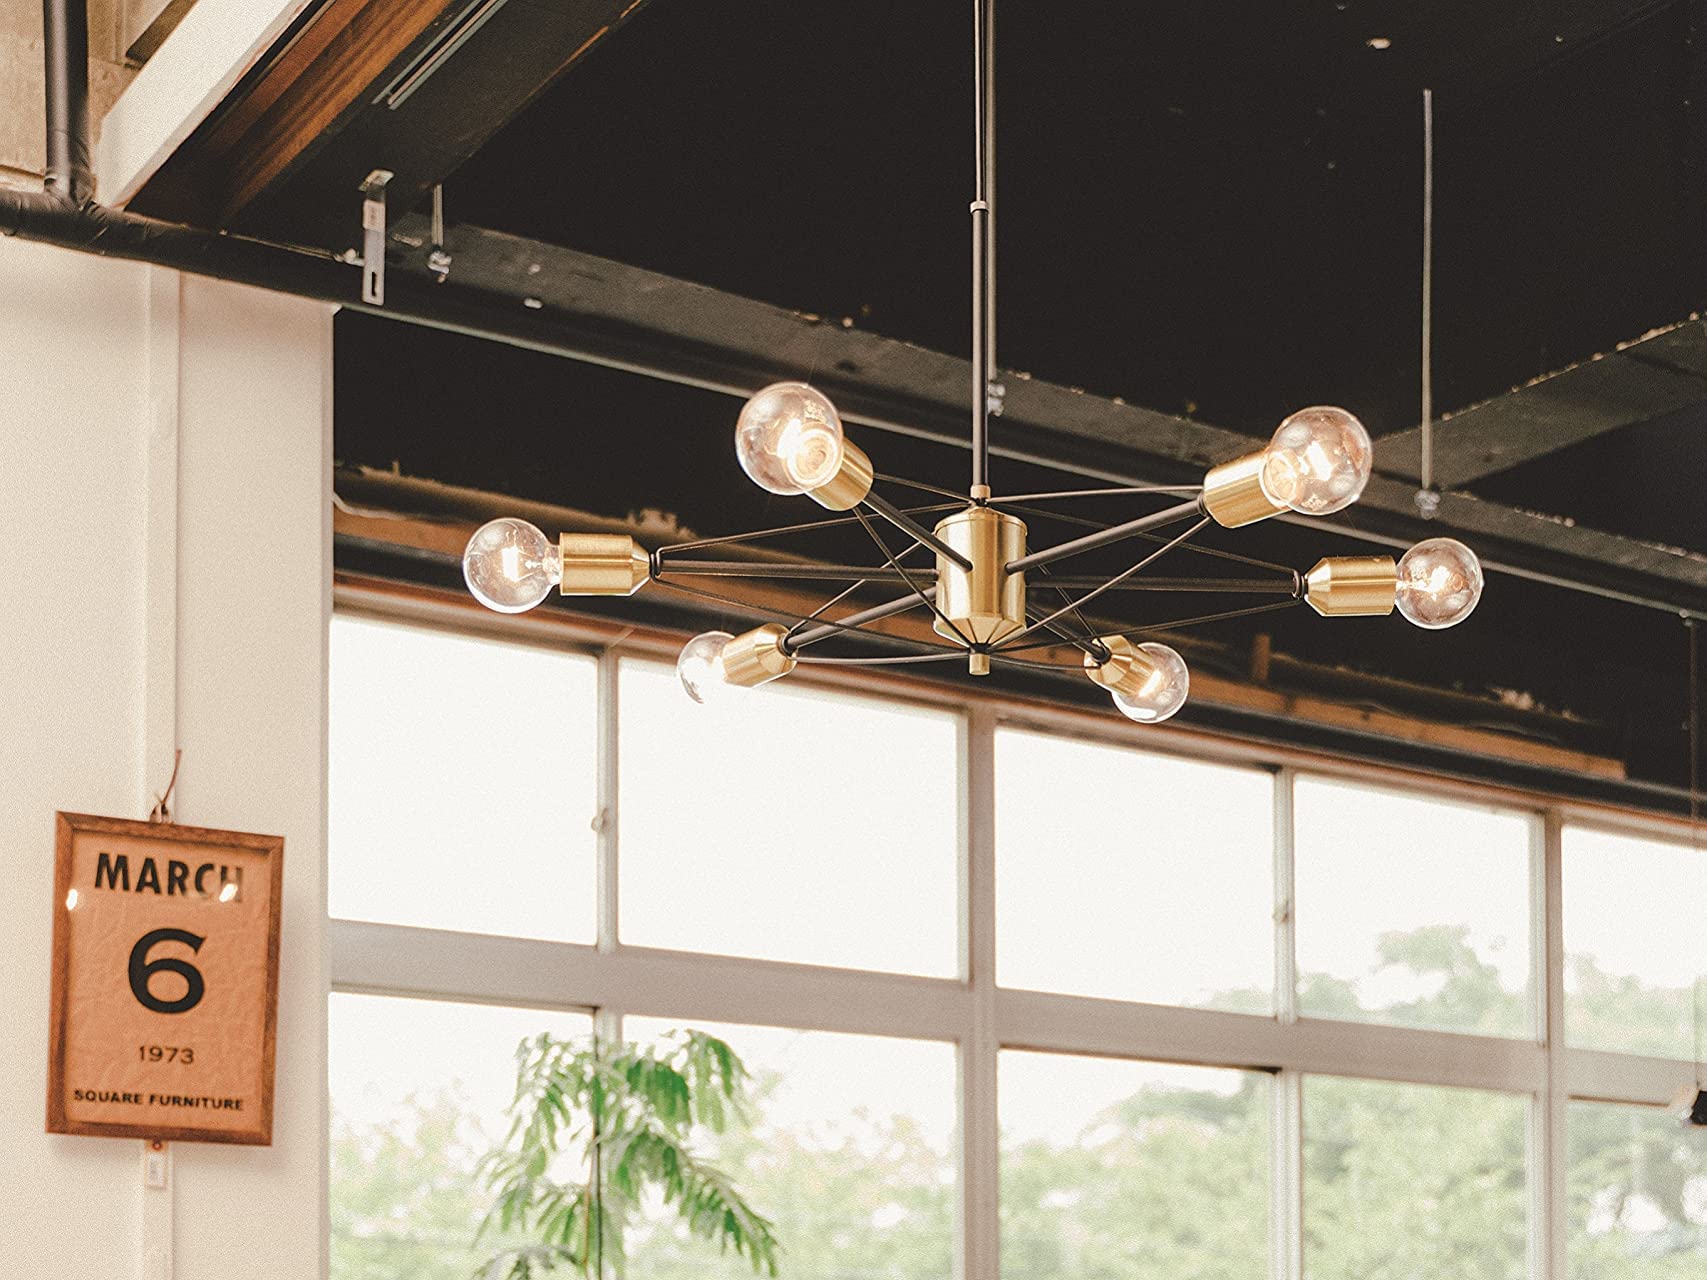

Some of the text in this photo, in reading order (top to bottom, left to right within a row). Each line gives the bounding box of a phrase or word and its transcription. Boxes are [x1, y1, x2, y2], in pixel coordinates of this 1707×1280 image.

[95, 853, 243, 902] MARCH
[128, 928, 207, 1014] 6
[139, 1045, 195, 1065] 1973
[74, 1089, 243, 1111] SQUARE FURNITURE
